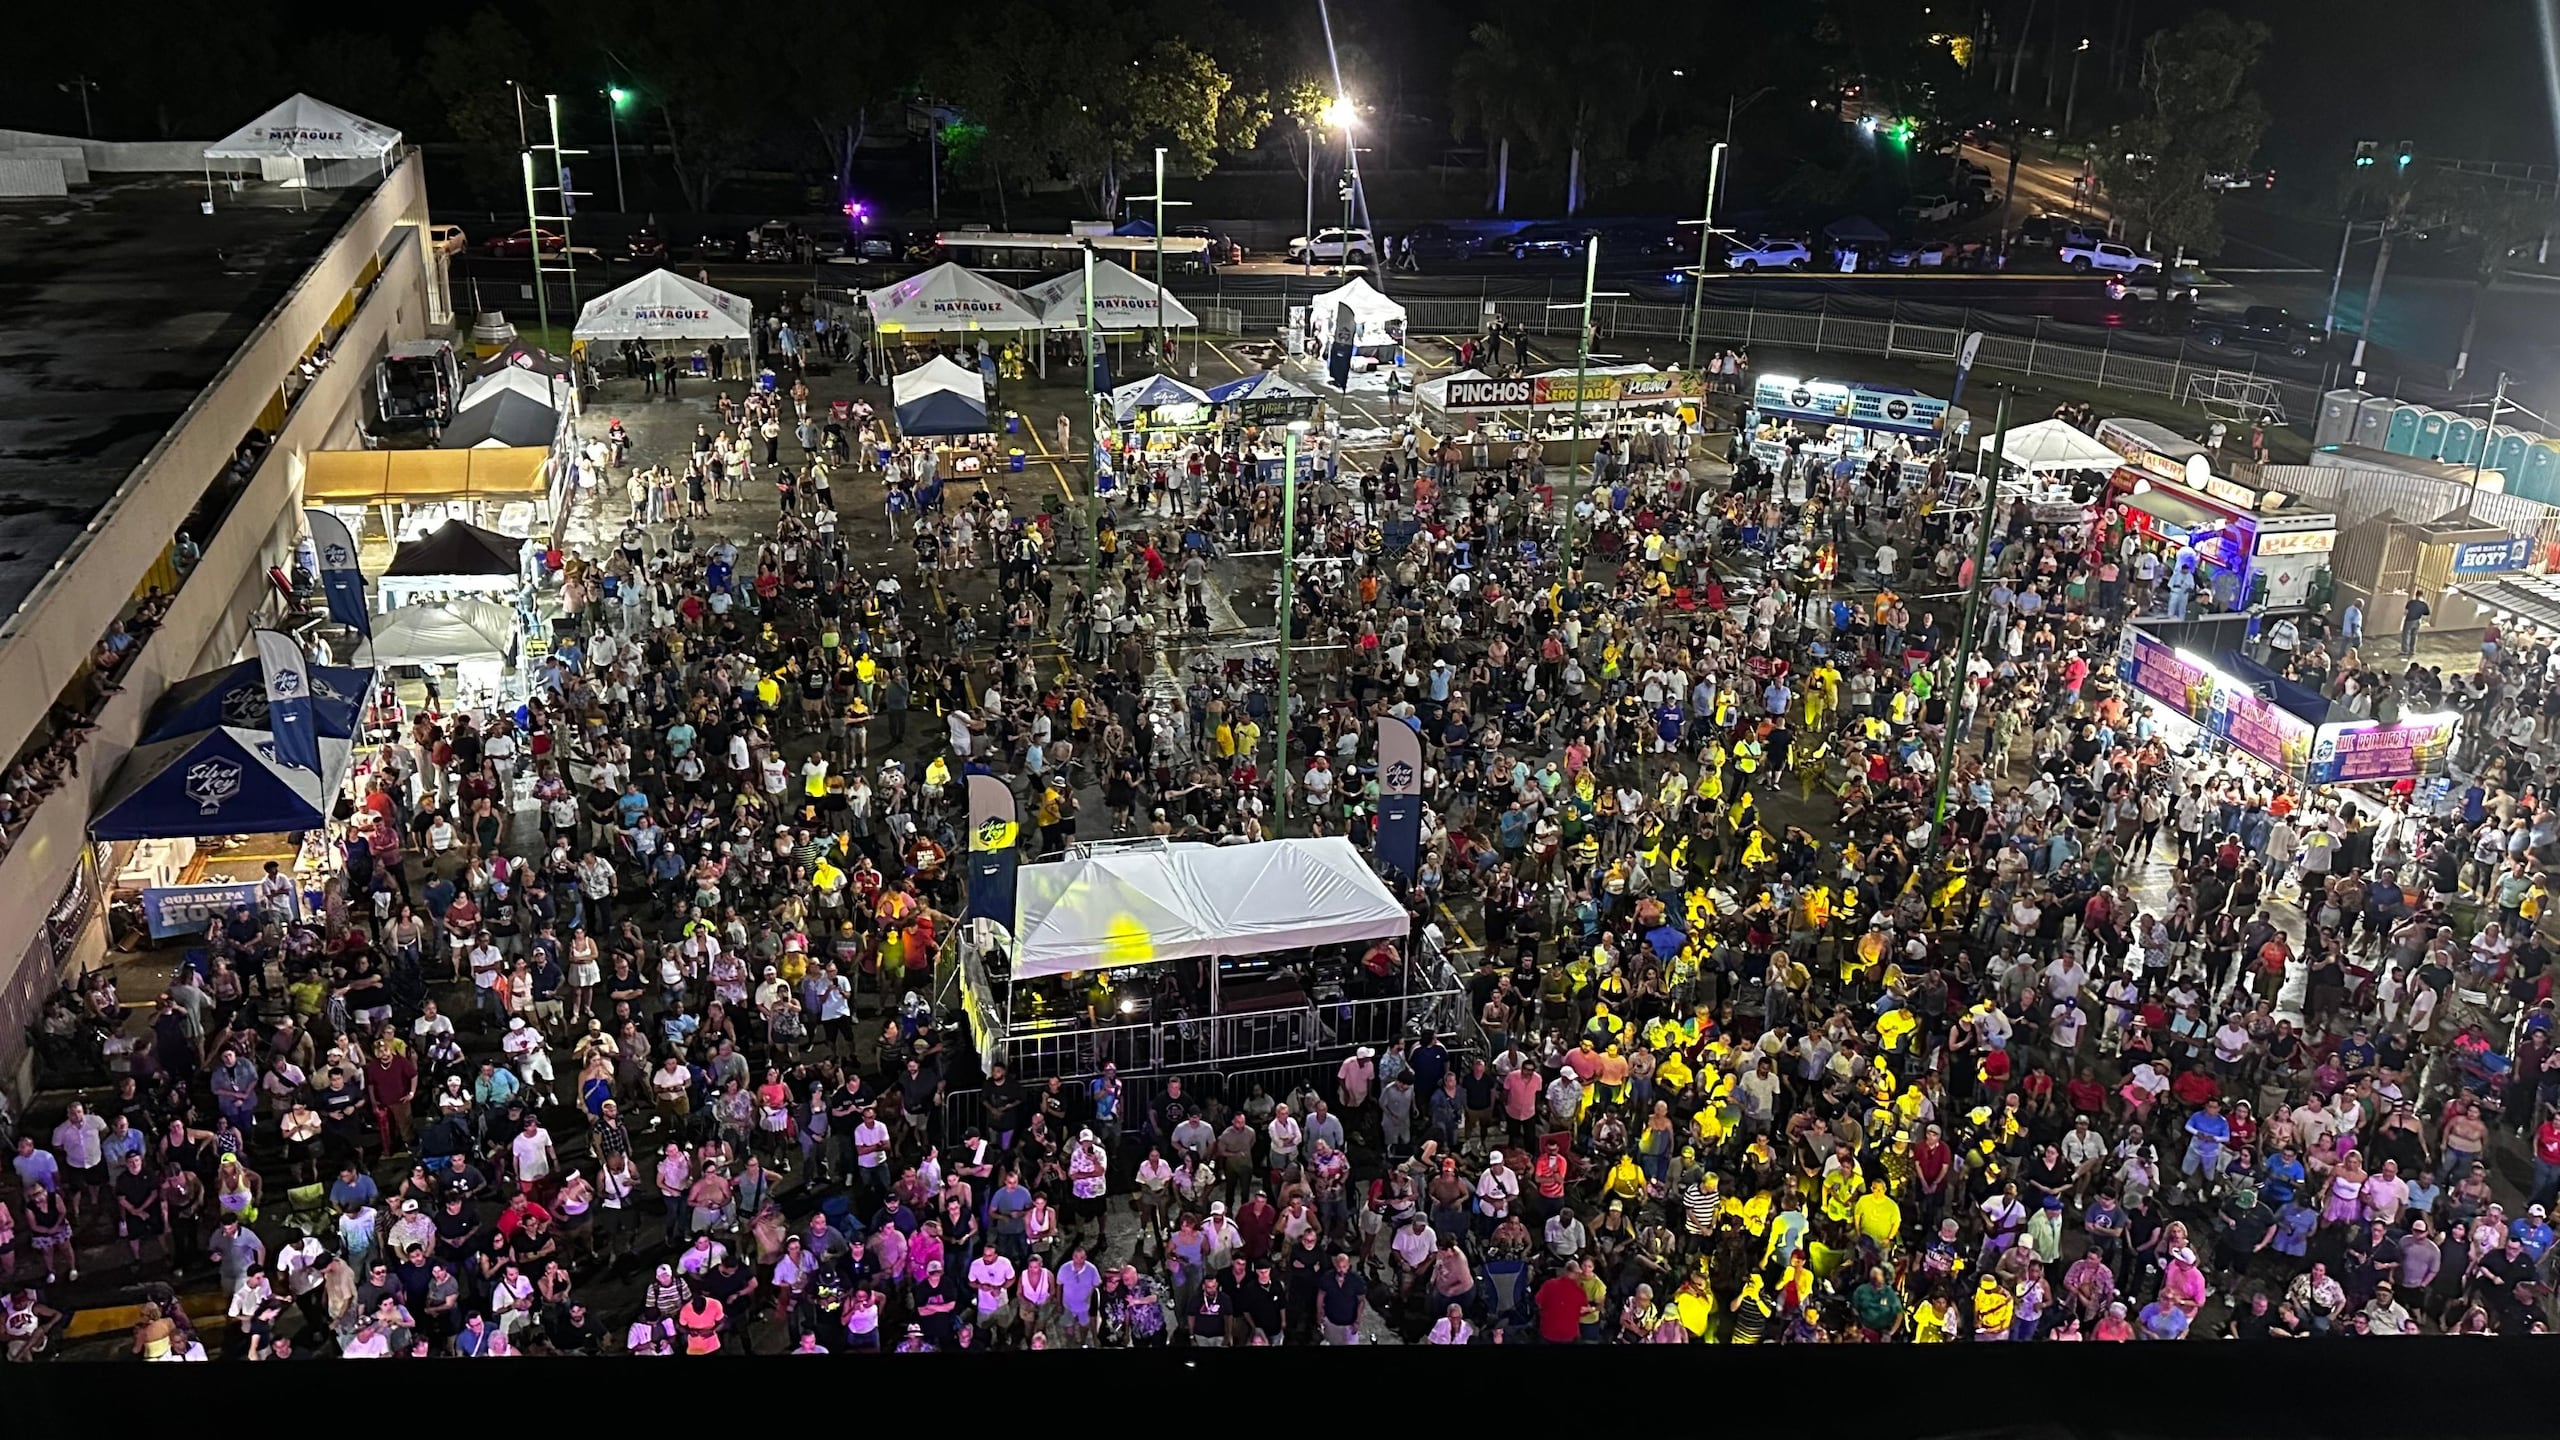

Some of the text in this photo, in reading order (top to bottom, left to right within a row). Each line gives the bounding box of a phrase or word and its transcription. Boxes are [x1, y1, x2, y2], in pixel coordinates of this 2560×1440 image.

[1451, 382, 1529, 403] PINCHOS
[2262, 535, 2330, 552] PIZZA
[2461, 552, 2507, 567] HOY?
[221, 687, 267, 704] Silve
[187, 764, 242, 779] Silver
[196, 777, 235, 794] Key
[194, 891, 222, 903] HAY
[222, 890, 245, 900] PA'
